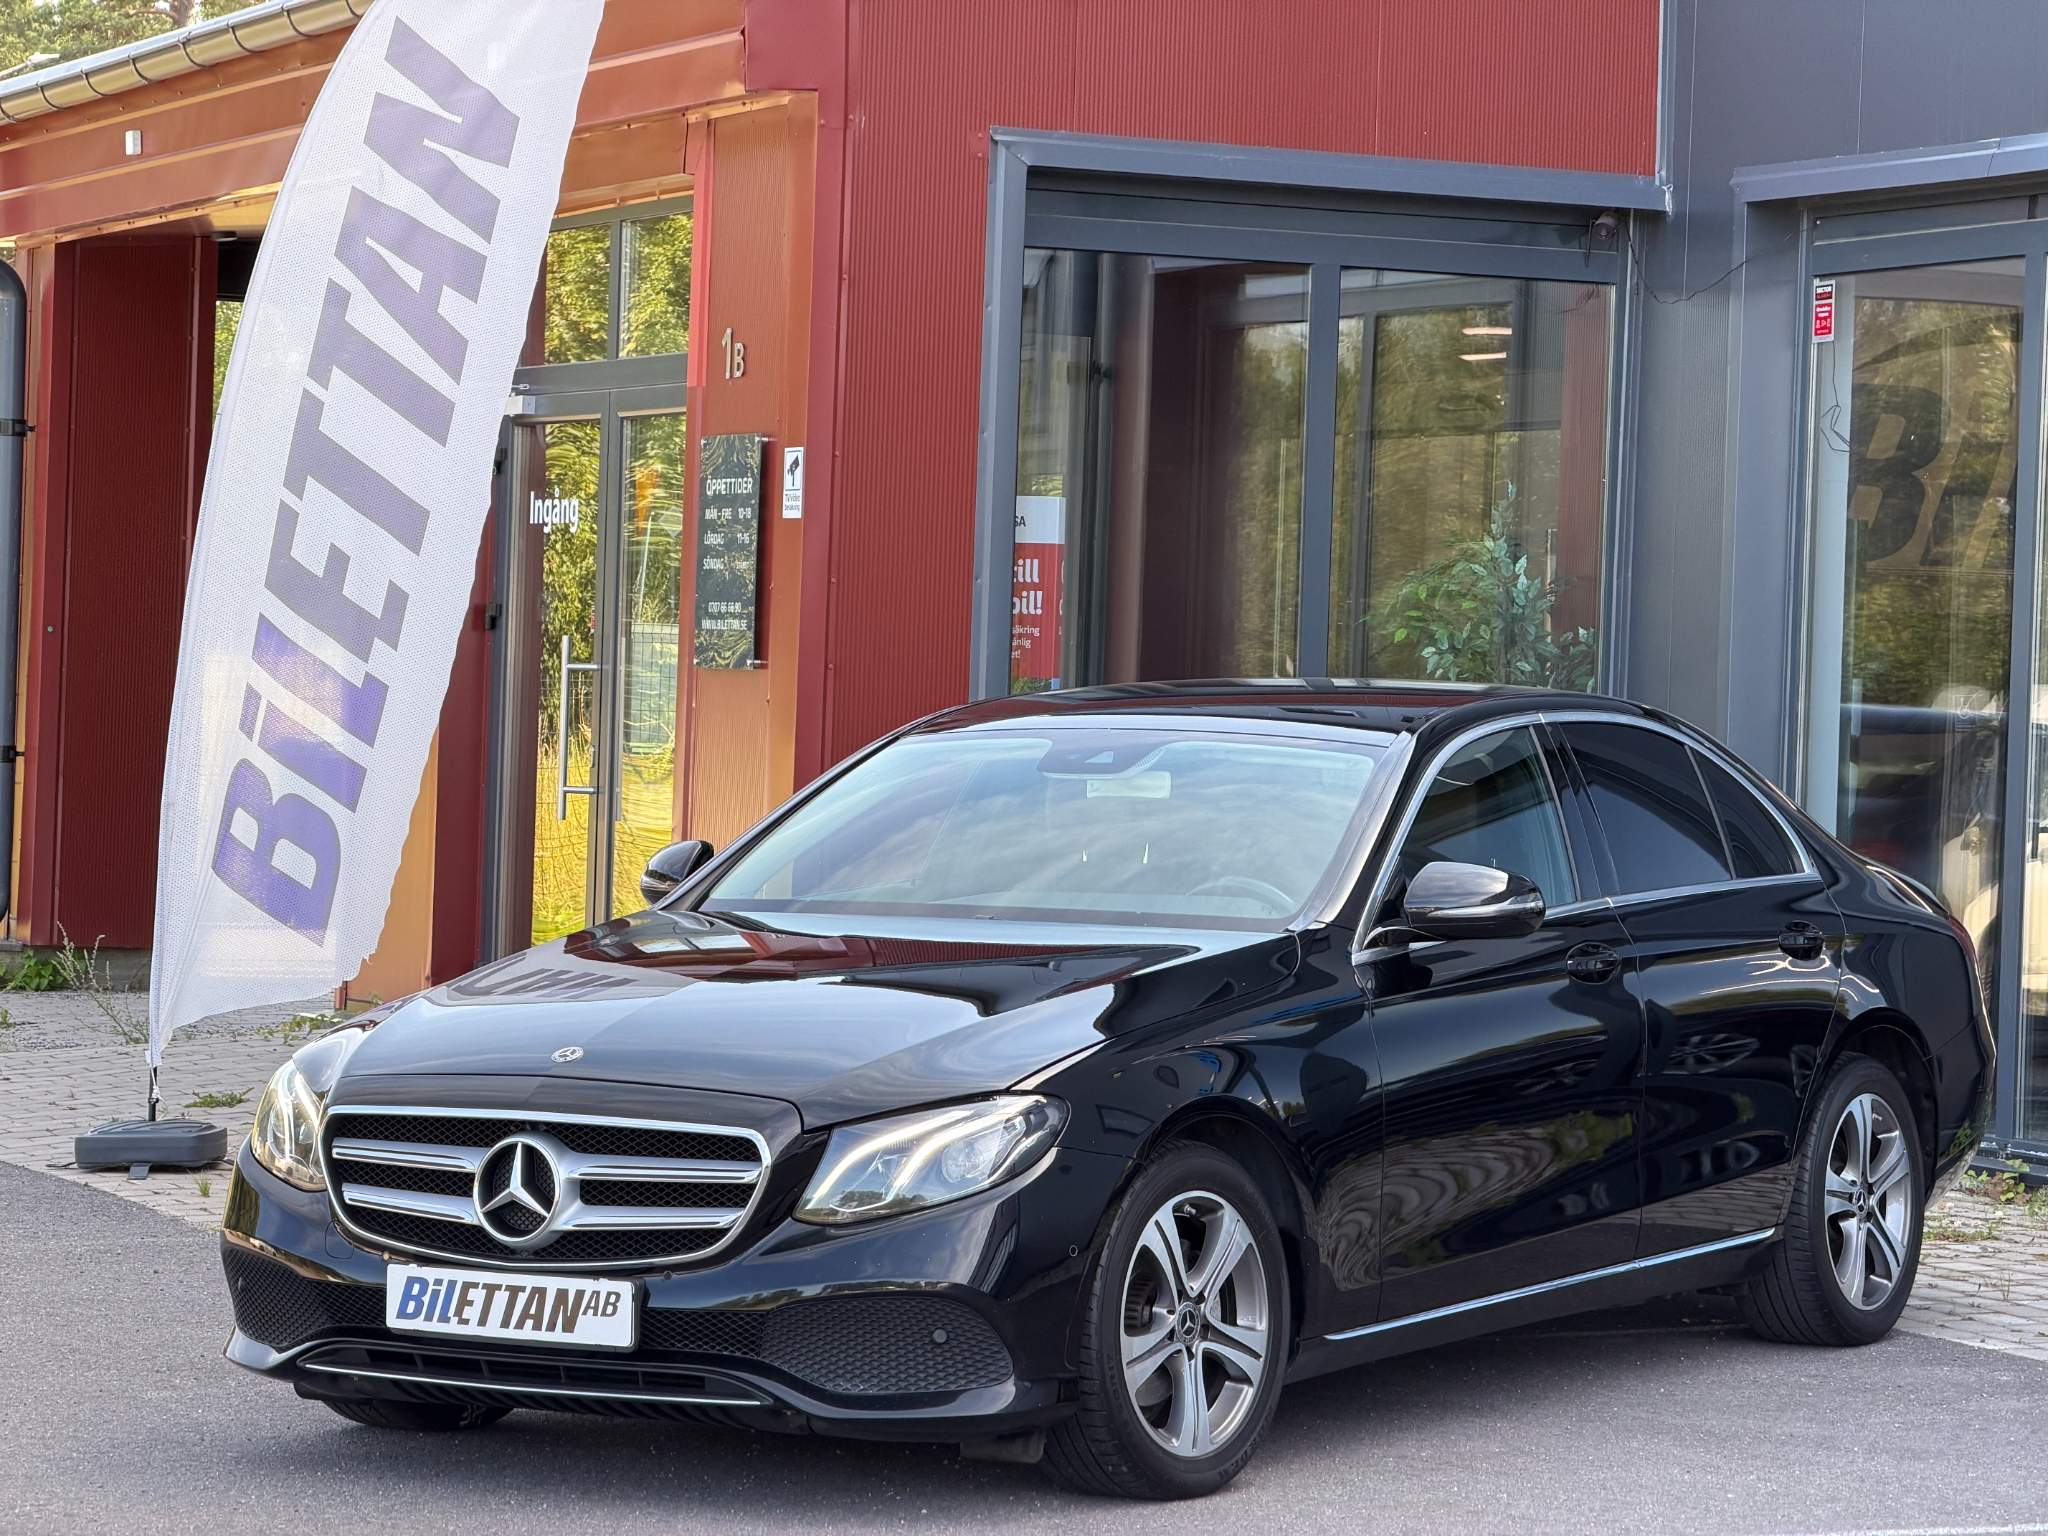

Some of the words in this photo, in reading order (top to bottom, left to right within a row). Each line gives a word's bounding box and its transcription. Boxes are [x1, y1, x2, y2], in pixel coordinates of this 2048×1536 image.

[706, 475, 753, 496] ÖPPETTIDER
[530, 487, 579, 534] Ingång
[704, 530, 725, 545] LÖRDAG
[703, 555, 724, 570] SÖNDAG
[582, 1290, 621, 1318] AB
